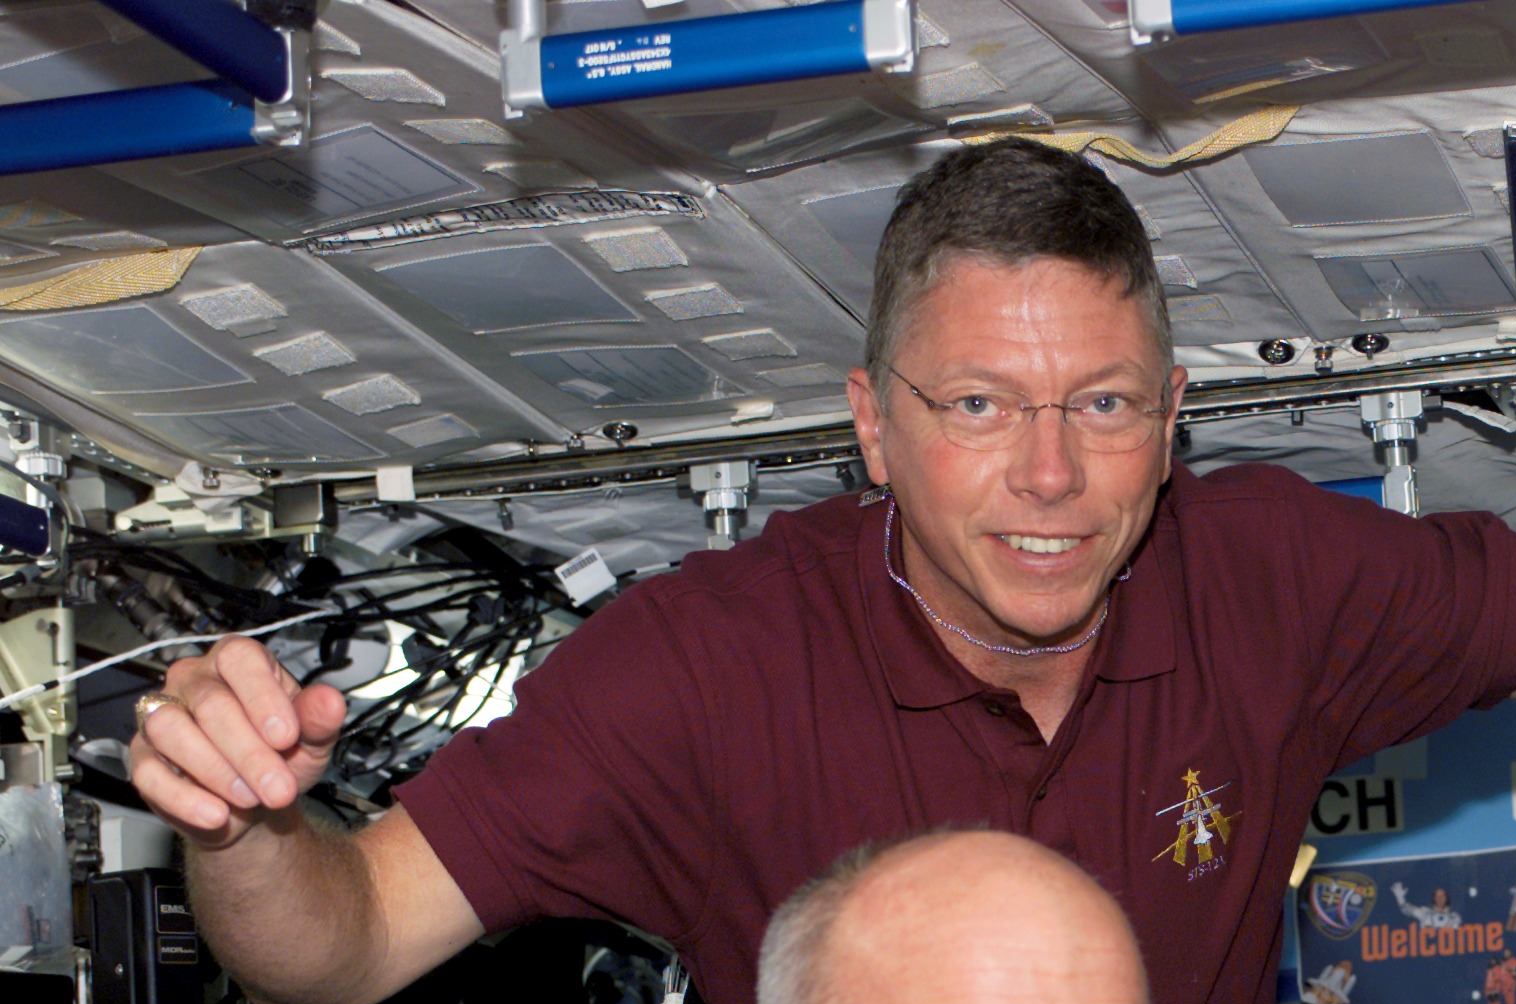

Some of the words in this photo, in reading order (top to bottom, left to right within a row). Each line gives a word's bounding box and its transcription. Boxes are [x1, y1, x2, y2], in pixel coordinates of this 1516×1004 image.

[654, 34, 671, 45] REV
[1188, 855, 1226, 882] STS-121
[1361, 920, 1504, 961] Welcome
